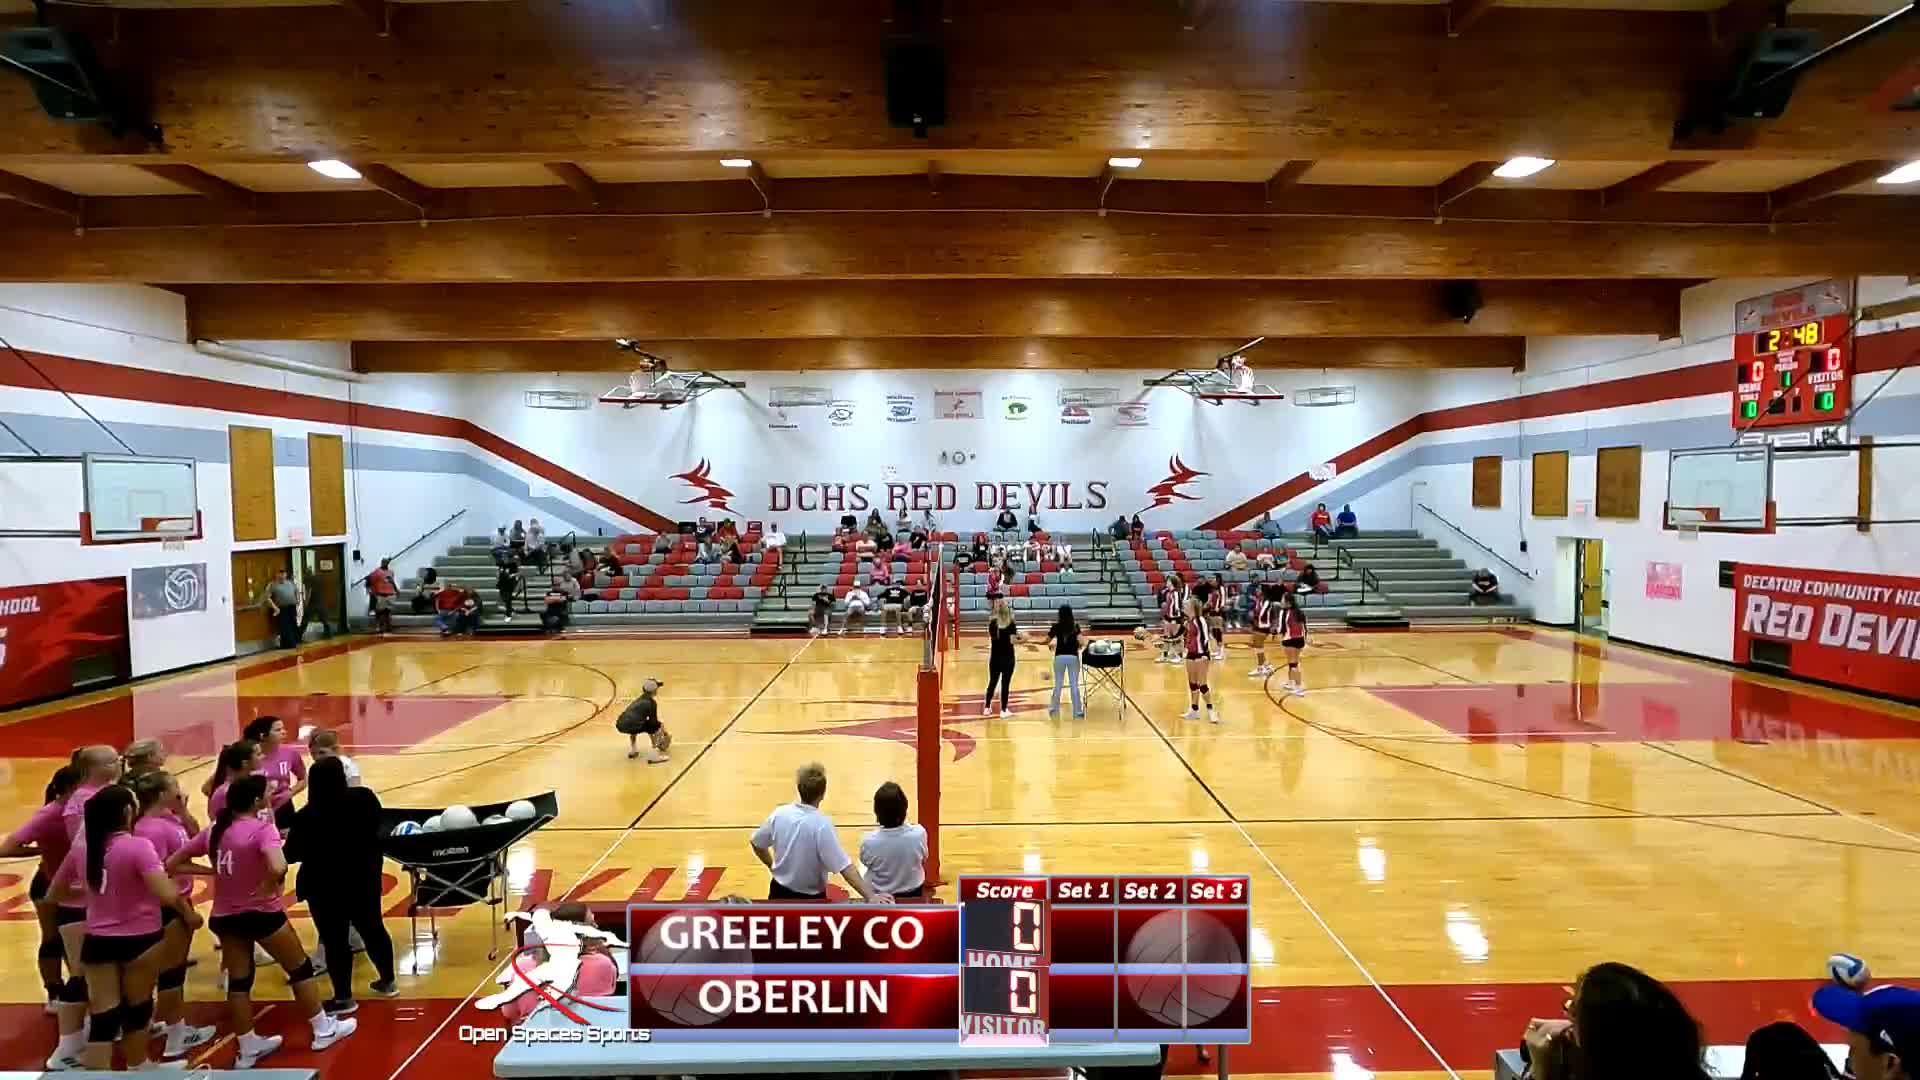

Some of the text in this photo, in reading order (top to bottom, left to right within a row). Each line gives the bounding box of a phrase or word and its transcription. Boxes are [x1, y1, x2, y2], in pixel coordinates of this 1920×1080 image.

[1768, 322, 1819, 352] 2:48
[1752, 361, 1765, 383] 0
[1827, 348, 1841, 370] 0
[768, 481, 1109, 513] DCHS RED DEVILS
[1743, 574, 1802, 594] DECATUR
[1804, 581, 1893, 604] COMMUNITY
[1742, 594, 1815, 641] RED
[216, 849, 234, 875] 14
